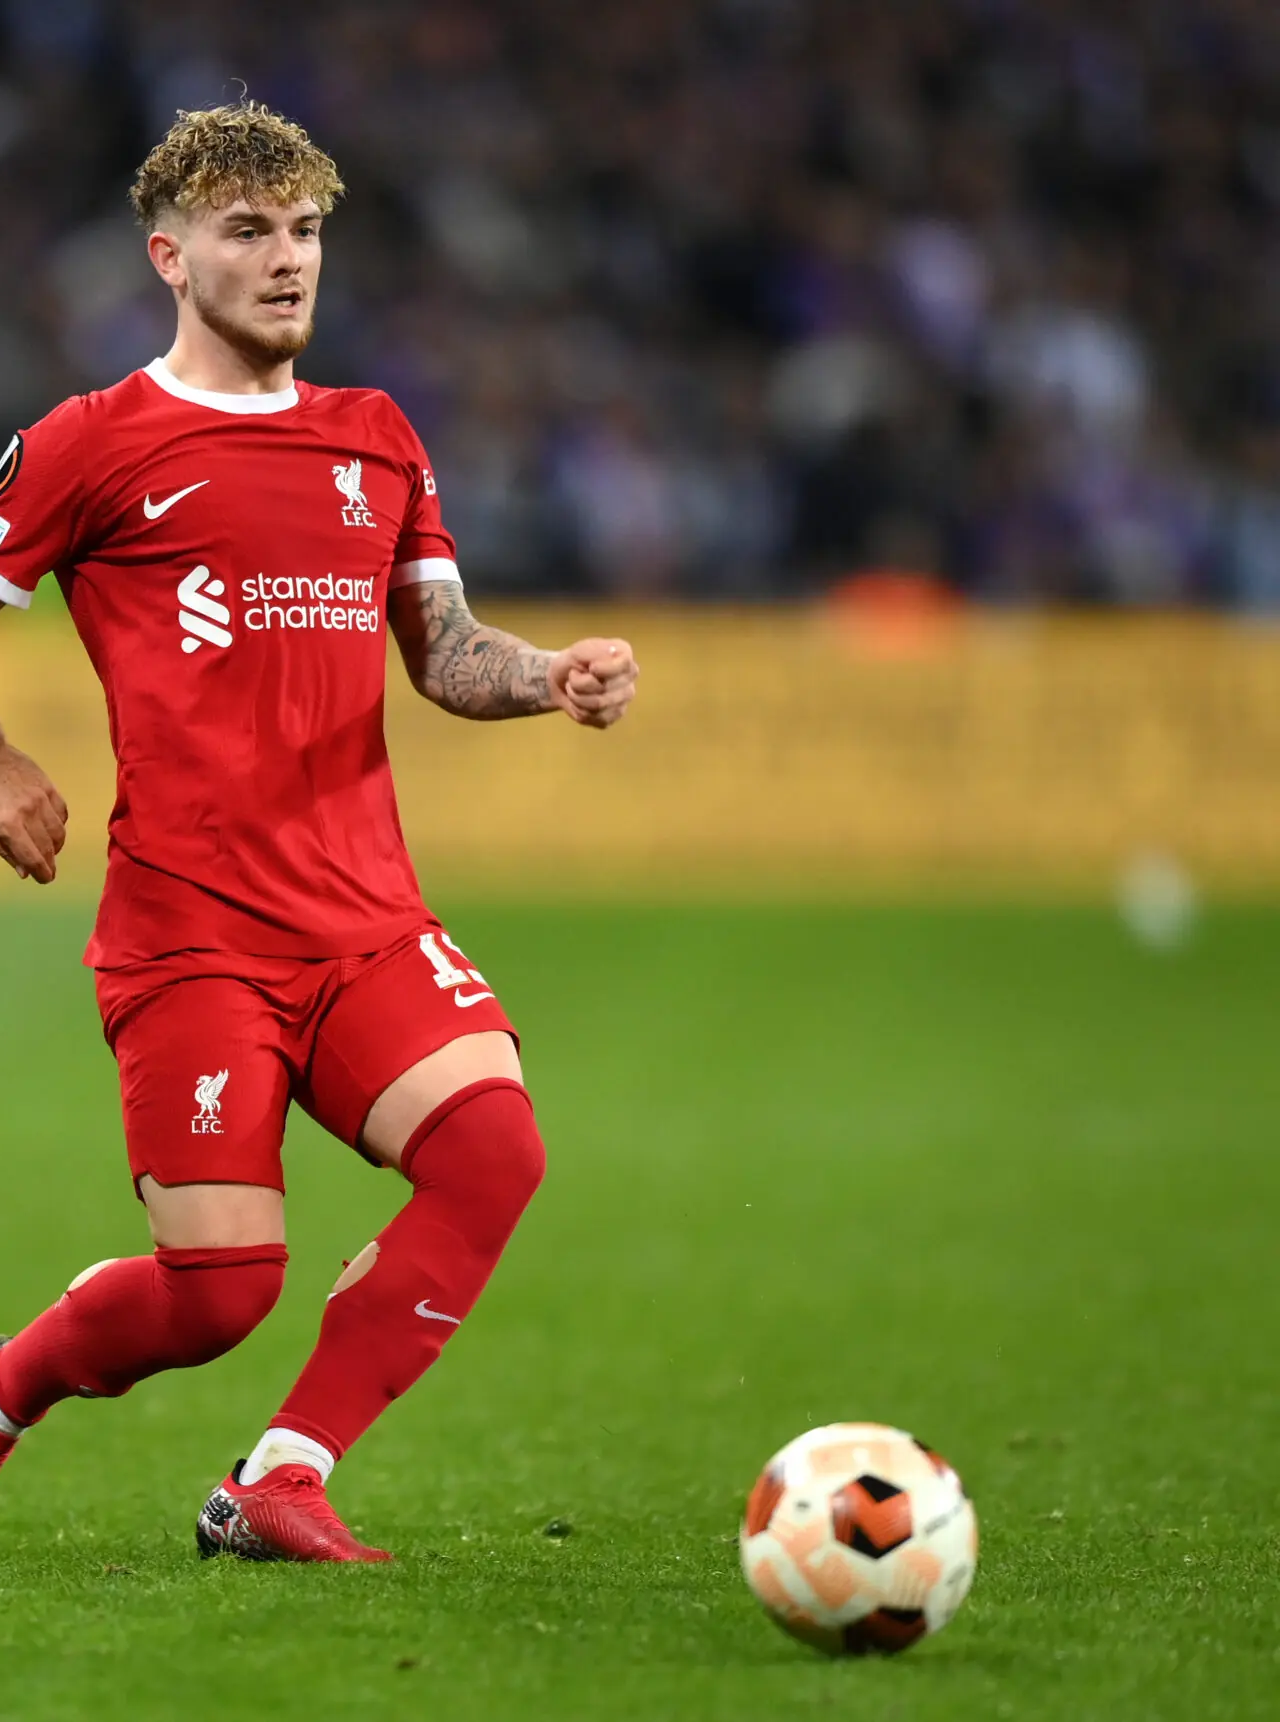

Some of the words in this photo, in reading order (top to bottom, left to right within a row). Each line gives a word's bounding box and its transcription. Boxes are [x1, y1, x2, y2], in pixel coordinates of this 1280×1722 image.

[241, 572, 374, 604] standard
[244, 601, 379, 633] chartered
[191, 1120, 225, 1134] L.F.C.
